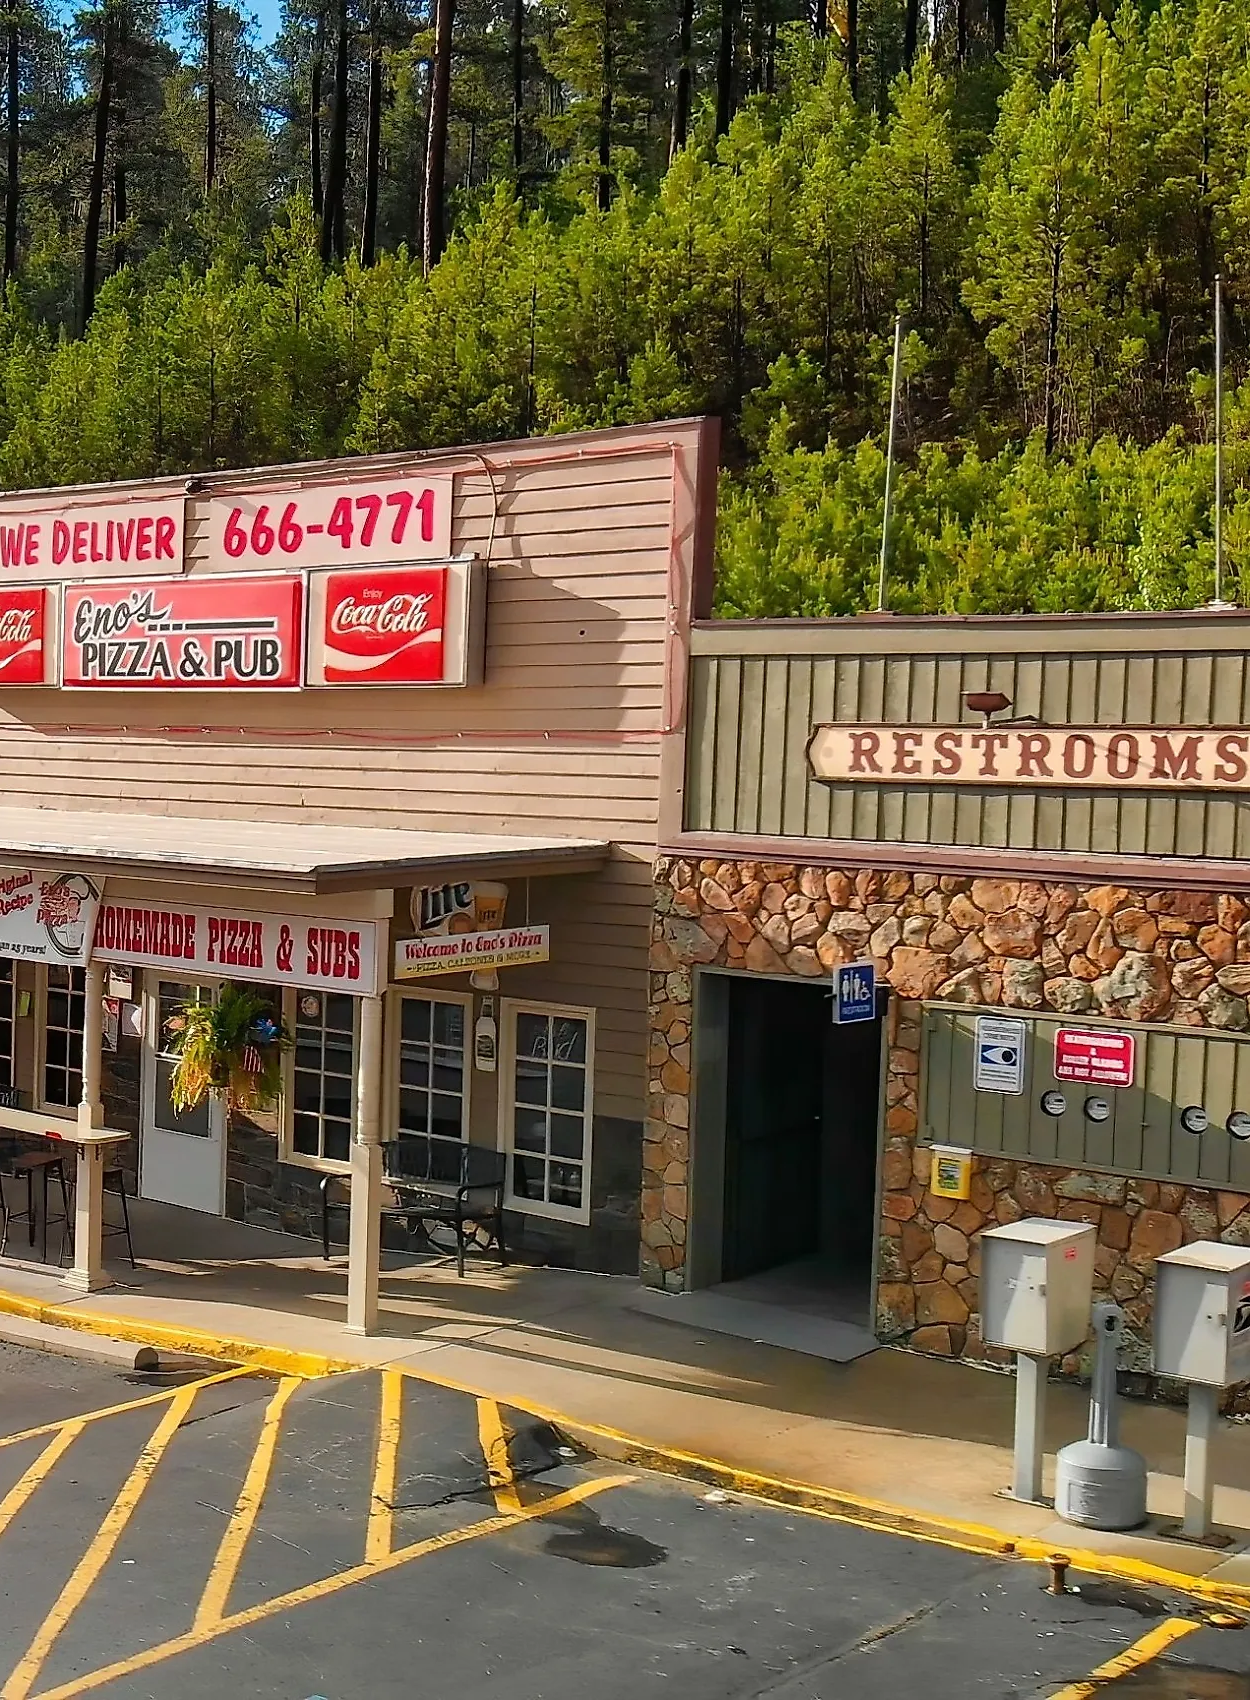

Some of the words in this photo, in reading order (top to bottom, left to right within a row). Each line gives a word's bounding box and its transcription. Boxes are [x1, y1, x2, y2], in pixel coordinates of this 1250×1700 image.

[0, 522, 41, 568] WE
[52, 516, 176, 565] DELIVER
[223, 489, 434, 558] 666-4771
[75, 591, 172, 644] Eno's
[331, 593, 433, 634] Coca-Cola
[82, 640, 171, 678] PIZZA
[179, 640, 206, 678] &
[214, 639, 280, 678] PUB
[848, 731, 1249, 782] RESTROOMS
[419, 882, 475, 931] Lite
[21, 944, 46, 954] years!
[93, 905, 196, 959] HOMEMADE
[207, 917, 263, 968] PIZZA
[276, 924, 294, 972] &
[307, 927, 360, 980] SUBS
[405, 942, 458, 960] Welcome
[475, 934, 505, 952] Eno's
[508, 931, 542, 948] Pizza
